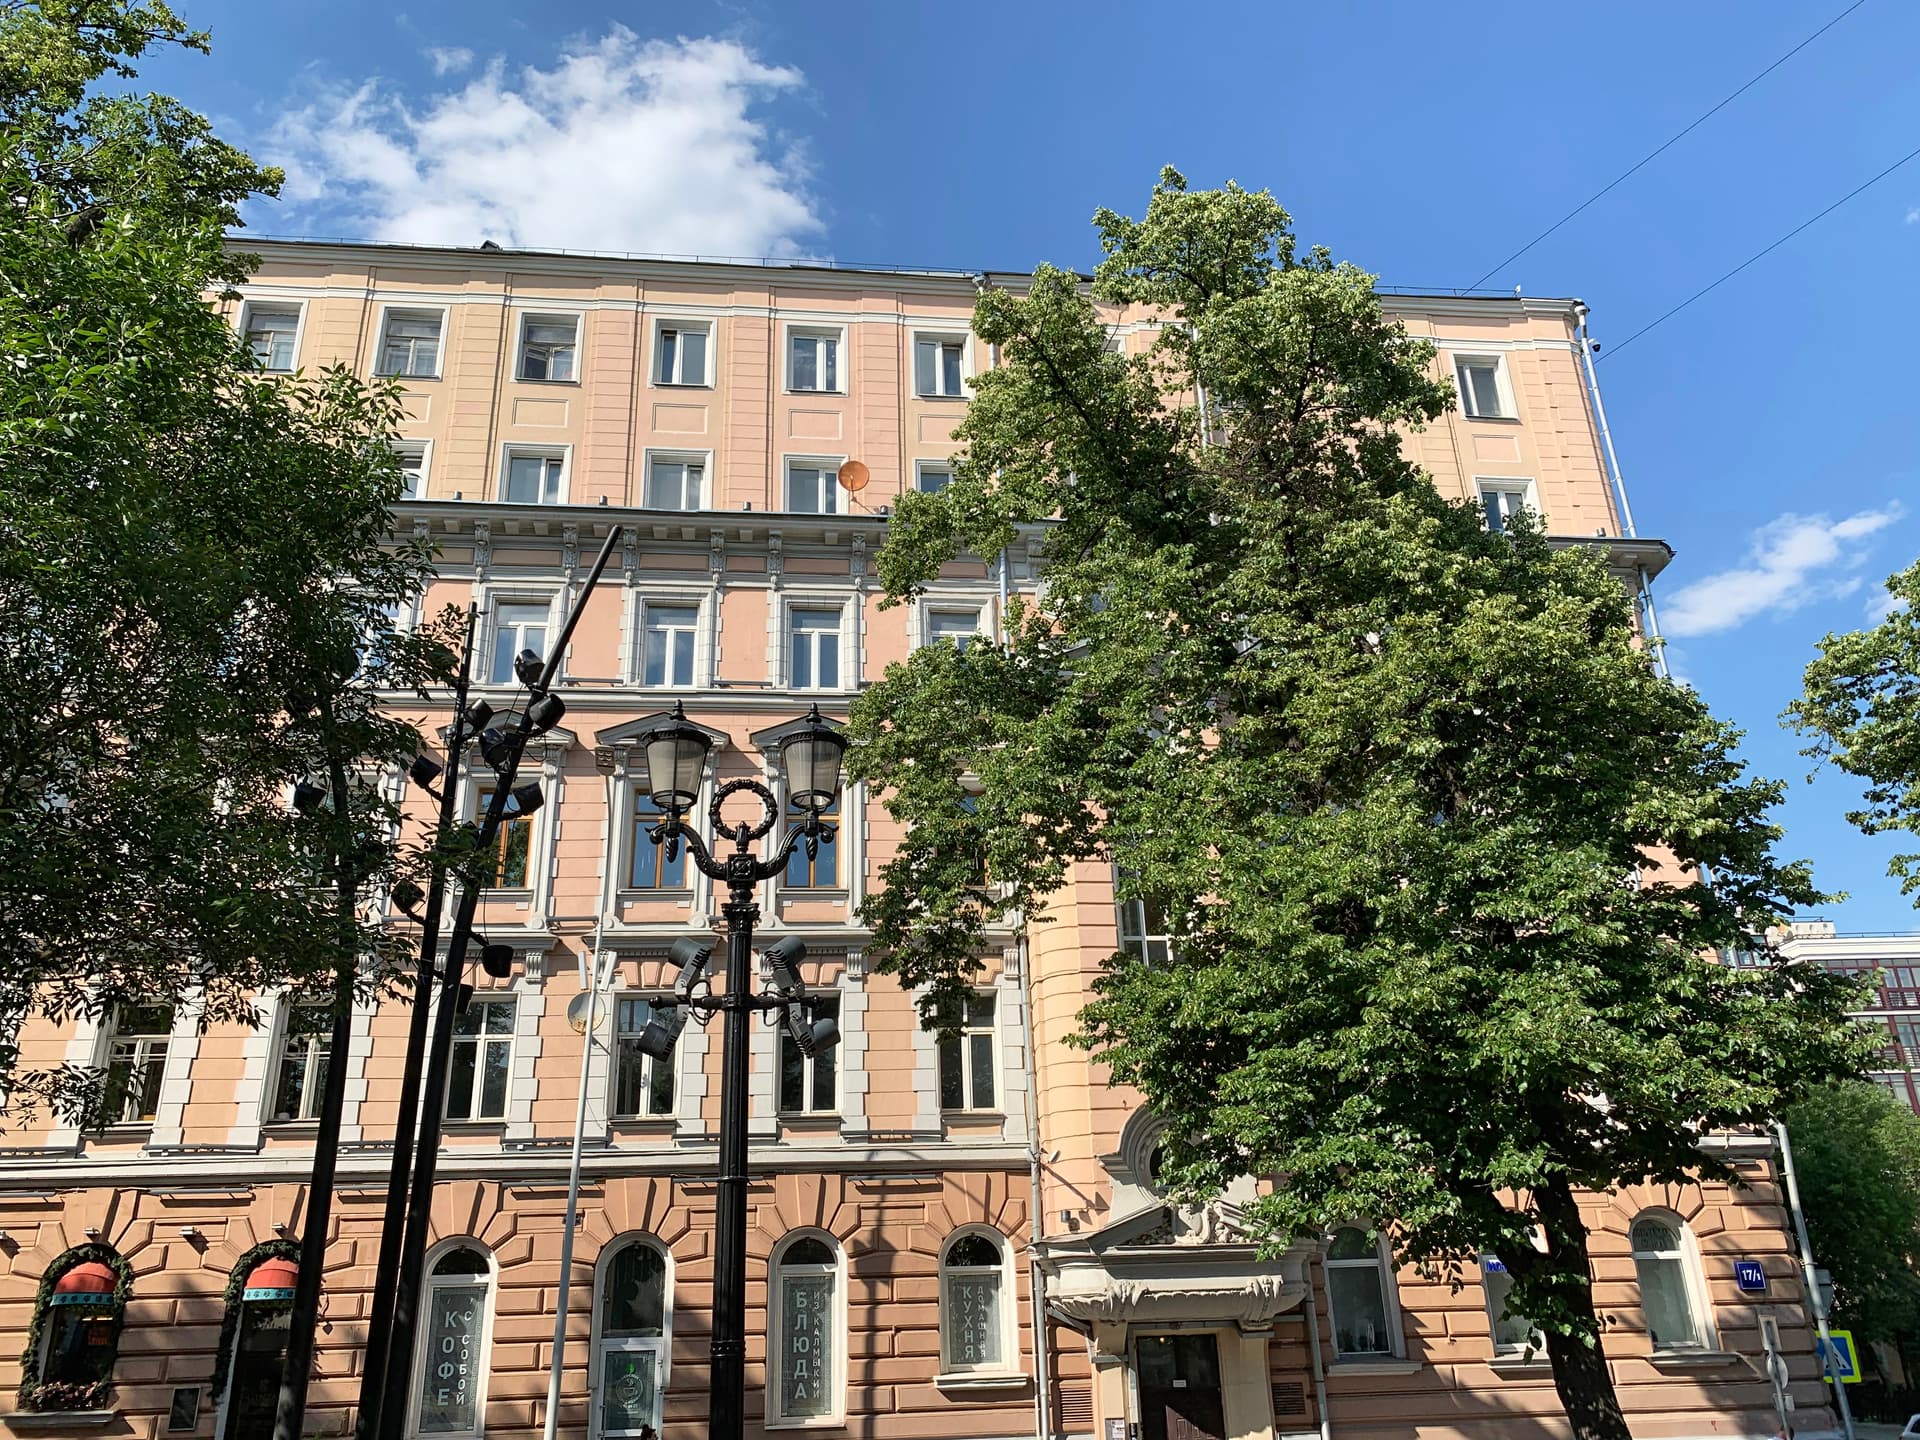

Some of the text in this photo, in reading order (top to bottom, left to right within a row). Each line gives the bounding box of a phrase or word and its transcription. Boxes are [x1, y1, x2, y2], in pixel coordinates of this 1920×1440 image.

[962, 1286, 974, 1359] КУХНЯ
[977, 1286, 986, 1358] ДОМАШНЯЯ
[1741, 1269, 1761, 1282] 17/1
[437, 1311, 458, 1406] КОФЕ
[456, 1310, 472, 1405] С СОБОЙ
[792, 1292, 810, 1399] БЛЮДА
[812, 1291, 820, 1399] ИЗ КАЛМЫКИИ
